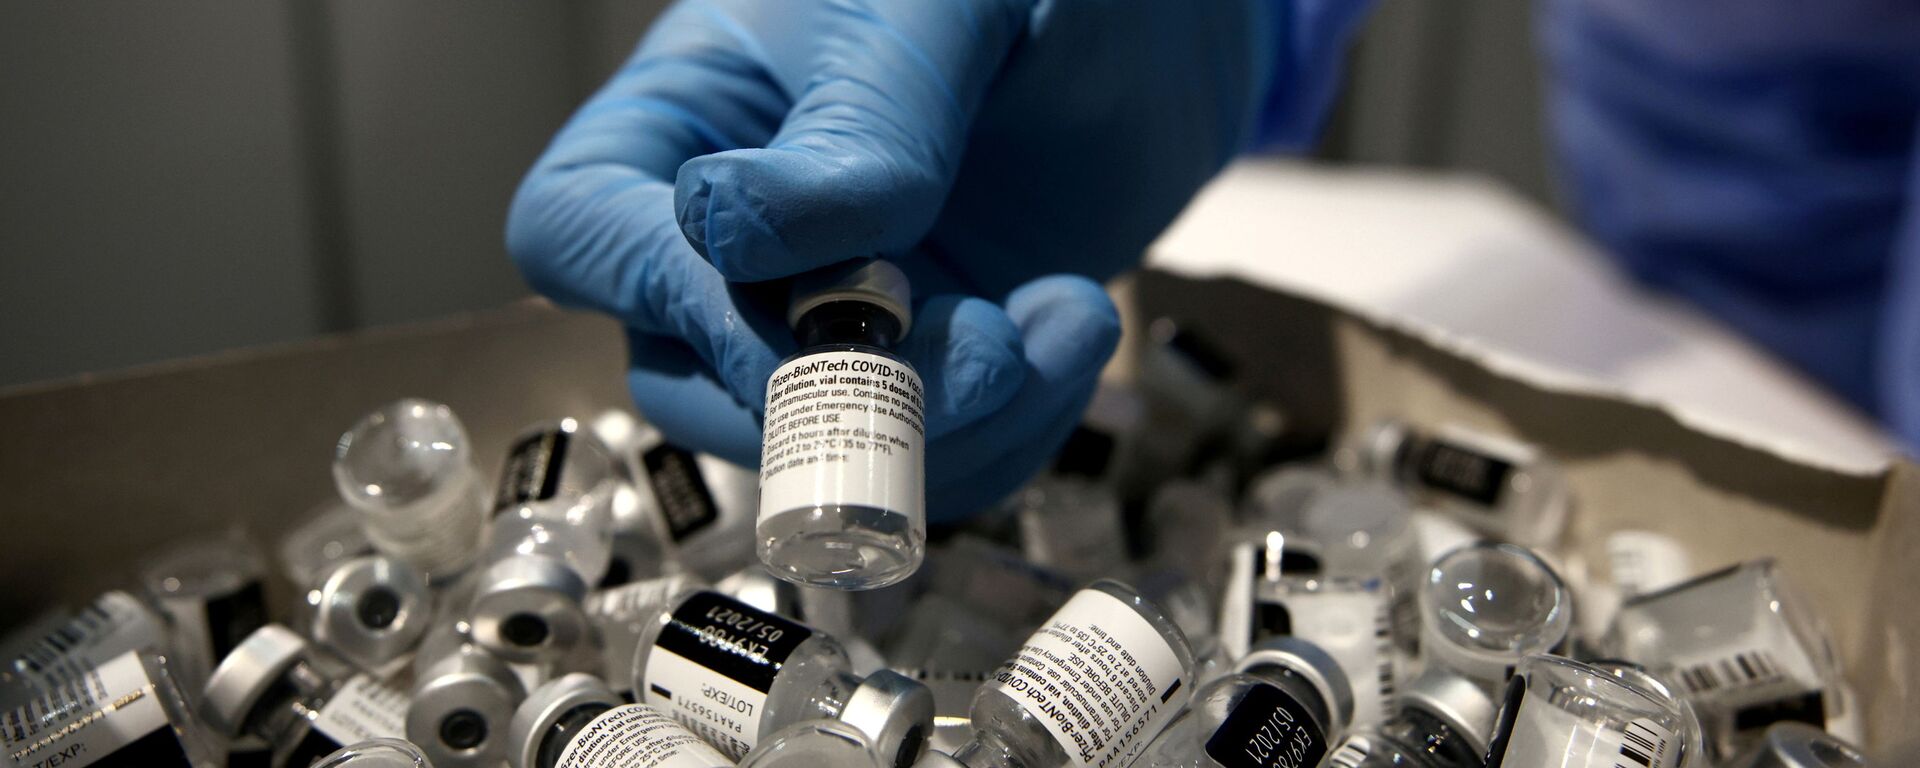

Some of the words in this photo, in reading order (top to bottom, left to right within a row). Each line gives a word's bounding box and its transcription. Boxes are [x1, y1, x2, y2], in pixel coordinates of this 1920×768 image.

[771, 359, 849, 393] Pfizer-BioNTech
[851, 360, 906, 383] COVID-19
[770, 390, 784, 404] After
[784, 379, 817, 395] dilution,
[819, 375, 837, 385] vial
[839, 376, 880, 388] contains
[882, 380, 887, 390] 5
[889, 382, 910, 399] doses
[769, 404, 778, 416] For
[778, 389, 829, 410] intramuscular
[831, 389, 850, 397] use.
[853, 388, 890, 403] Contains
[891, 397, 901, 407] no
[768, 418, 777, 429] For
[777, 412, 789, 423] use
[790, 404, 814, 417] under
[816, 401, 868, 413] Emergency
[768, 423, 787, 442] DILUTE
[788, 415, 820, 431] BEFORE
[767, 434, 790, 455] Discard
[791, 433, 797, 442] 6
[827, 427, 850, 436] after
[888, 435, 910, 451] when
[785, 447, 794, 456] at
[802, 442, 812, 452] to
[856, 441, 866, 450] to
[706, 606, 784, 643] 05/2021
[1069, 626, 1078, 634] to
[1089, 624, 1107, 640] time:
[1071, 641, 1090, 655] after
[1075, 631, 1090, 642] (35
[1087, 639, 1108, 657] 25°C
[1105, 637, 1122, 651] and
[1041, 650, 1082, 683] Emergency
[1067, 652, 1084, 669] USE.
[1090, 653, 1112, 677] hours
[1107, 654, 1116, 664] to
[1114, 661, 1122, 671] 2
[1120, 649, 1136, 667] date
[1016, 665, 1046, 685] contains
[1047, 667, 1061, 681] use.
[1082, 665, 1112, 696] BEFORE
[1109, 674, 1118, 682] 6
[1120, 667, 1130, 678] at
[1135, 665, 1156, 696] Dilution
[700, 682, 754, 717] LOT/EXP:
[1043, 683, 1061, 698] vial
[1079, 680, 1102, 703] under
[1114, 680, 1140, 713] Discard
[1126, 677, 1147, 703] stored
[678, 695, 742, 733] PAA156571
[1059, 680, 1104, 729] intramuscular
[1062, 695, 1091, 730] dilution,
[1100, 701, 1114, 717] use
[1109, 693, 1131, 723] DILUTE
[608, 720, 625, 733] vial
[1026, 687, 1095, 763] Pfizer-BioNTech
[1099, 704, 1156, 768] PAA156571
[1101, 727, 1113, 742] For
[1110, 717, 1122, 733] For
[1245, 706, 1294, 764] 05/2021
[599, 744, 620, 766] under
[620, 724, 664, 745] Emergency
[645, 738, 664, 750] after
[1088, 728, 1105, 751] After
